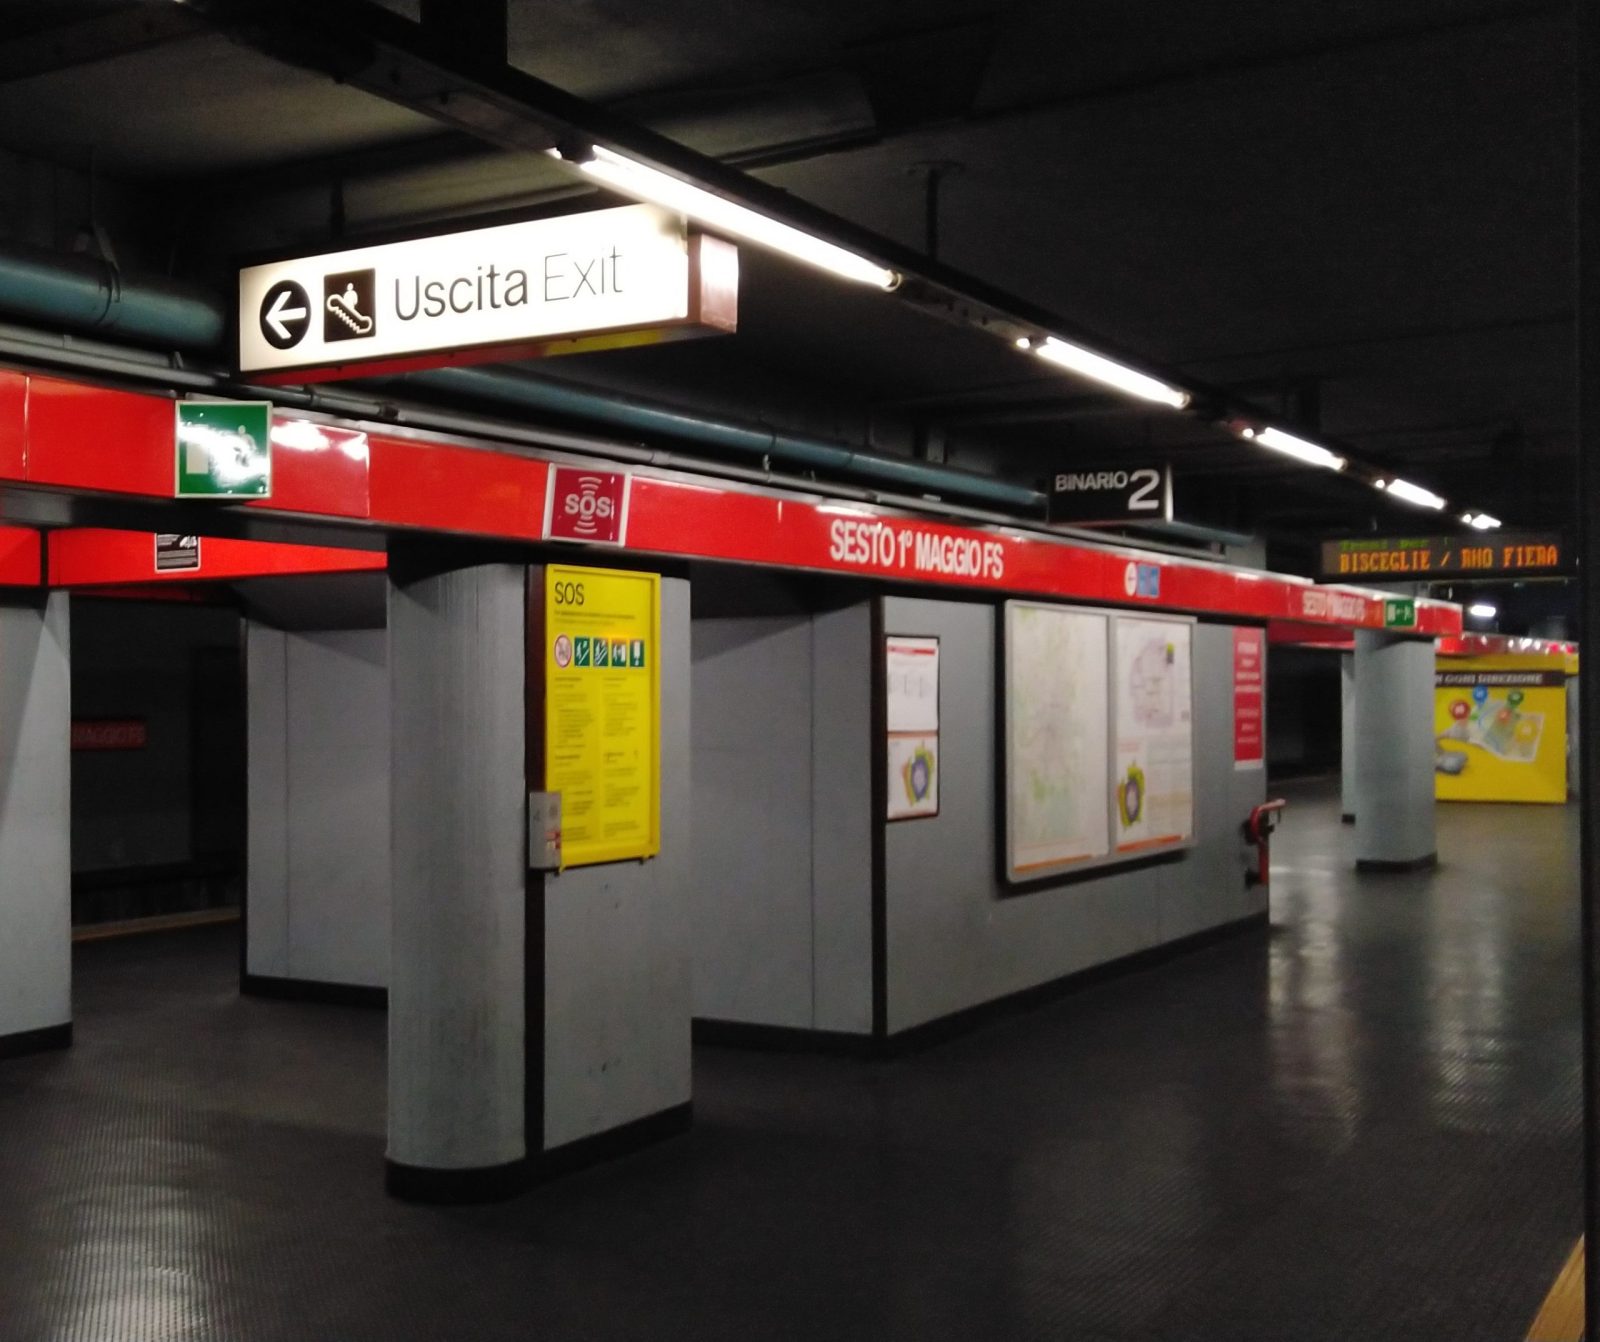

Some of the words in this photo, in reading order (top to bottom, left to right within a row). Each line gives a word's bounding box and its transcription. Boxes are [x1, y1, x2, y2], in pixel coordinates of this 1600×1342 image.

[395, 264, 528, 321] Uscita
[545, 245, 623, 302] Exit
[565, 493, 611, 518] SOS
[1056, 471, 1128, 491] BINARIO
[1128, 469, 1160, 510] 2
[830, 519, 895, 567] SESTO
[915, 532, 982, 576] MAGGIO
[983, 541, 1004, 579] FS
[1340, 551, 1431, 572] BISCEGLIE
[1503, 545, 1558, 567] FIERA
[554, 581, 585, 606] SOS
